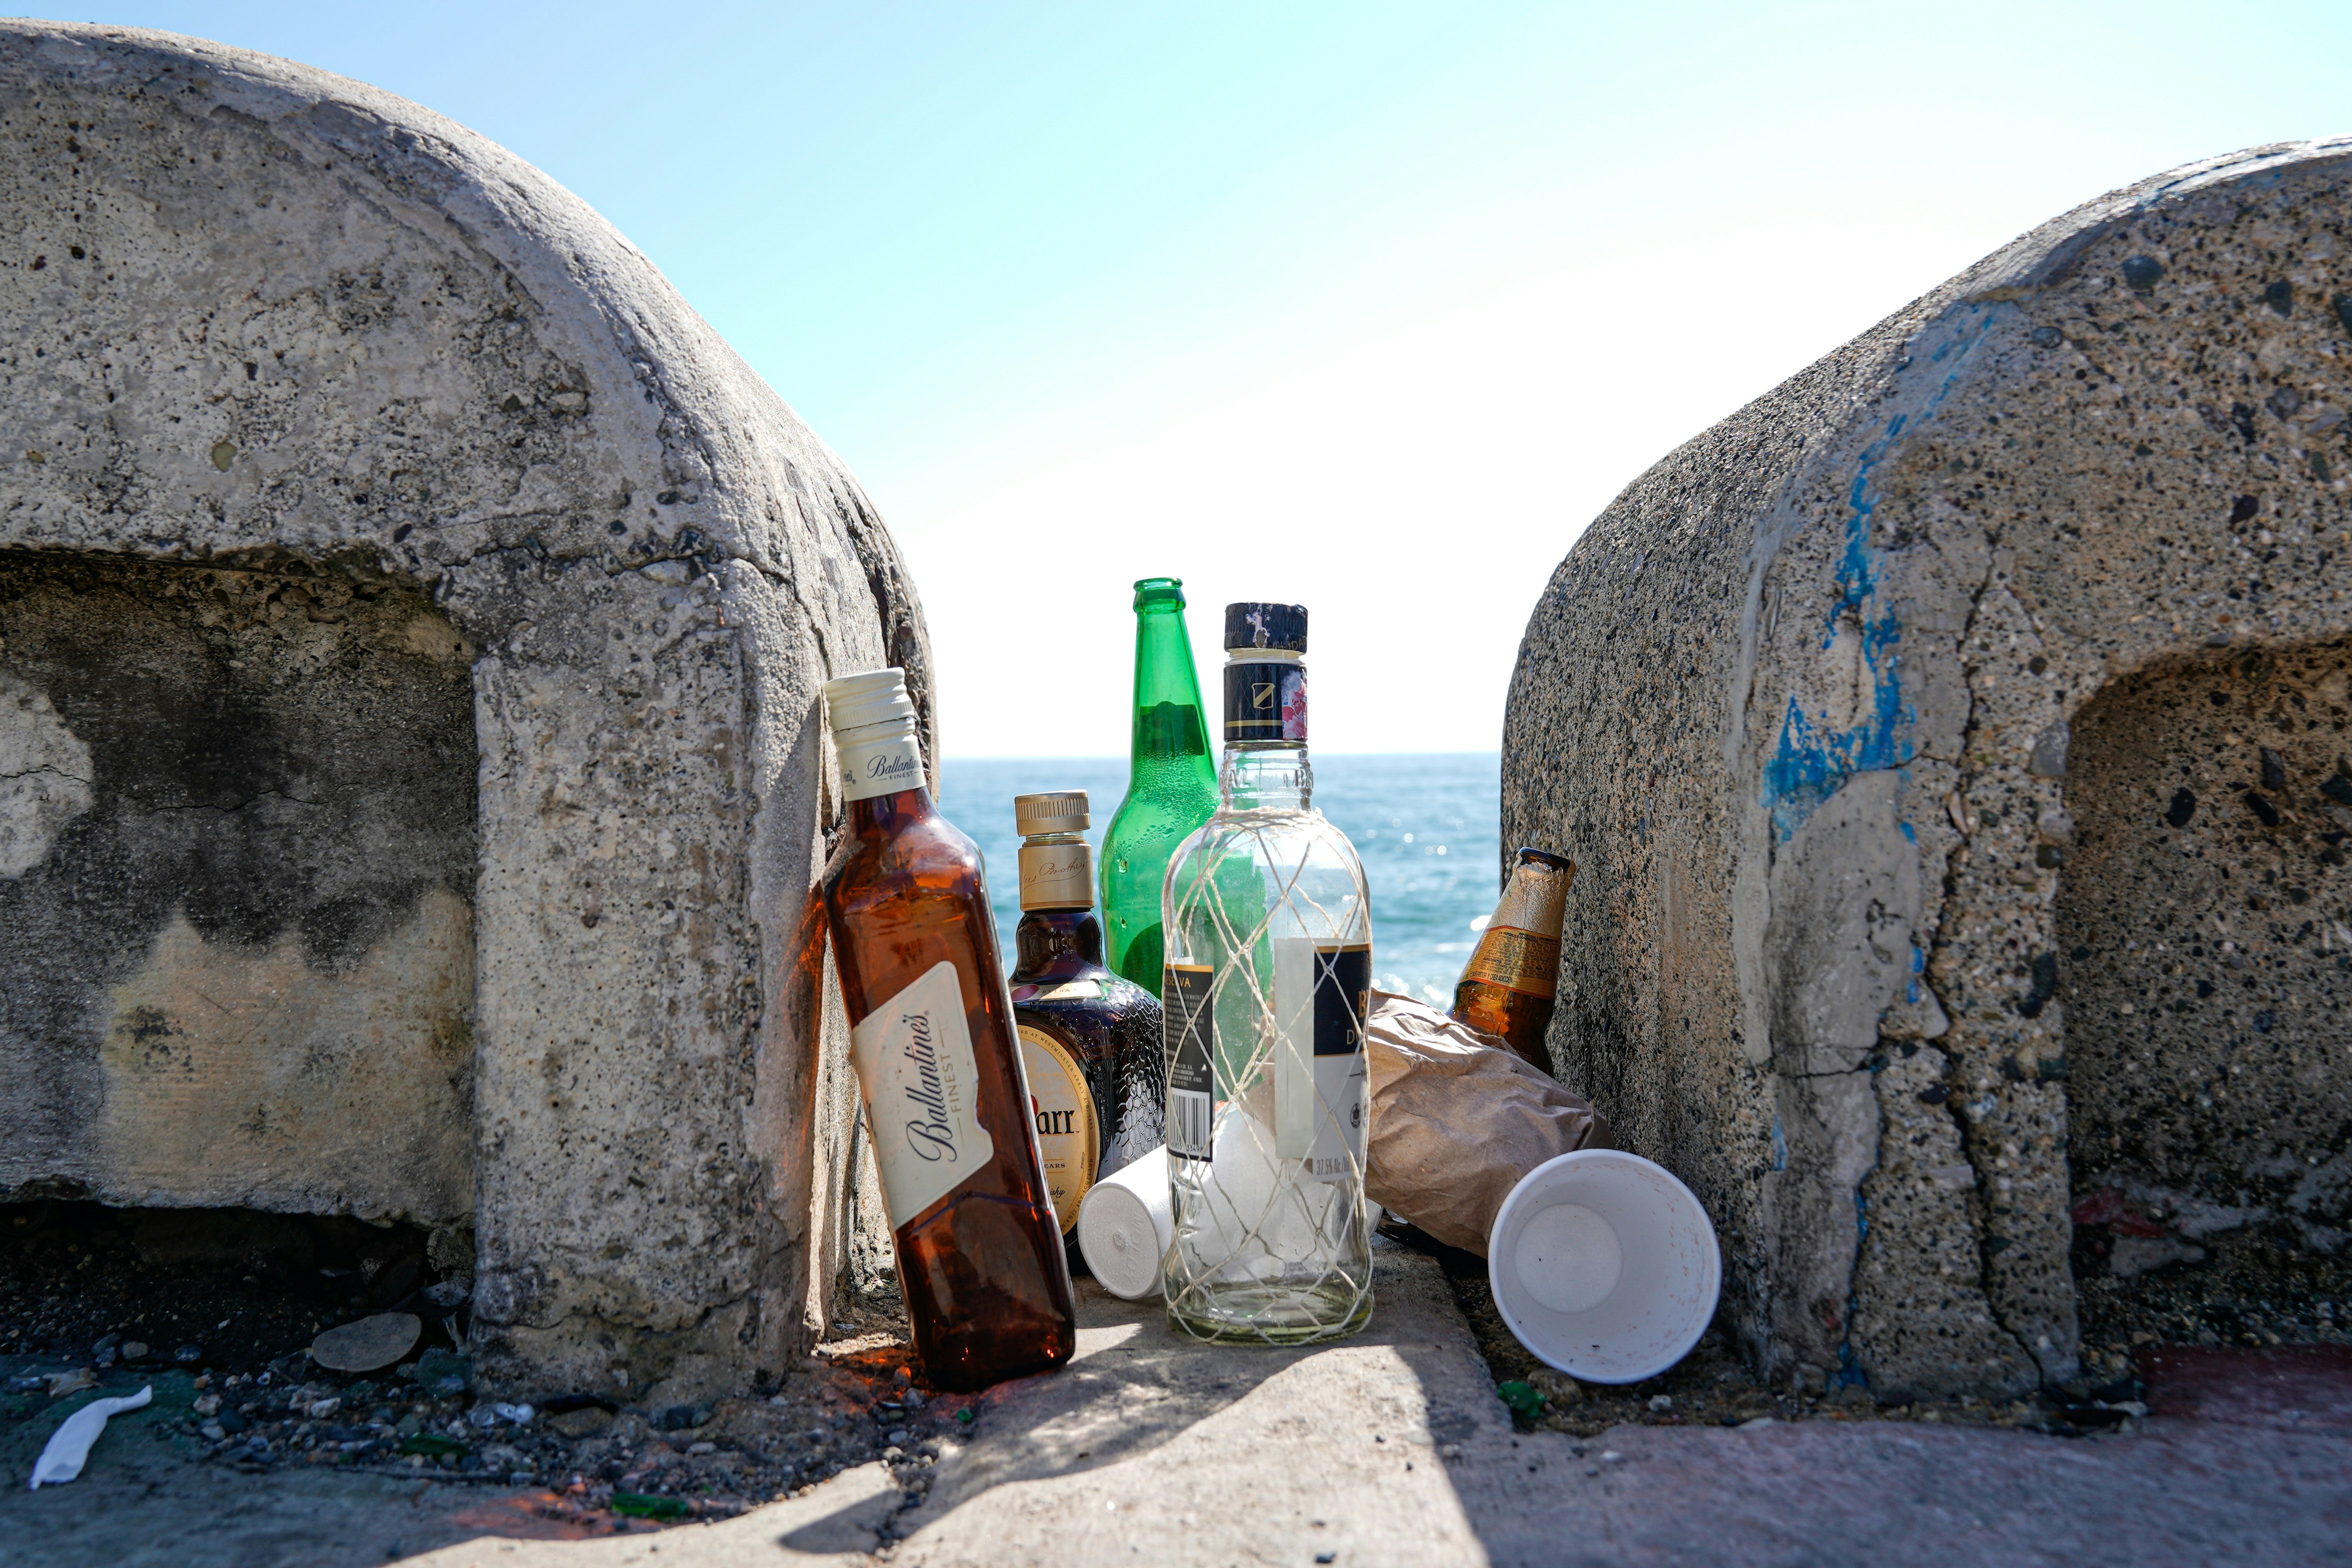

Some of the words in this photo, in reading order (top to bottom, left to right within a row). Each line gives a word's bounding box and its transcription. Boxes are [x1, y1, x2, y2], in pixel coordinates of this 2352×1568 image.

[890, 771, 913, 780] FINEST
[1040, 1037, 1074, 1072] WESTMINSTER
[1073, 1075, 1085, 1094] ABBEY
[903, 1014, 957, 1163] Ballantine's
[940, 1053, 962, 1113] FINEST
[1032, 1103, 1075, 1134] arr
[1082, 1159, 1093, 1194] SCOTLAND
[1317, 1158, 1333, 1175] 37.5%
[1048, 1186, 1065, 1198] isky
